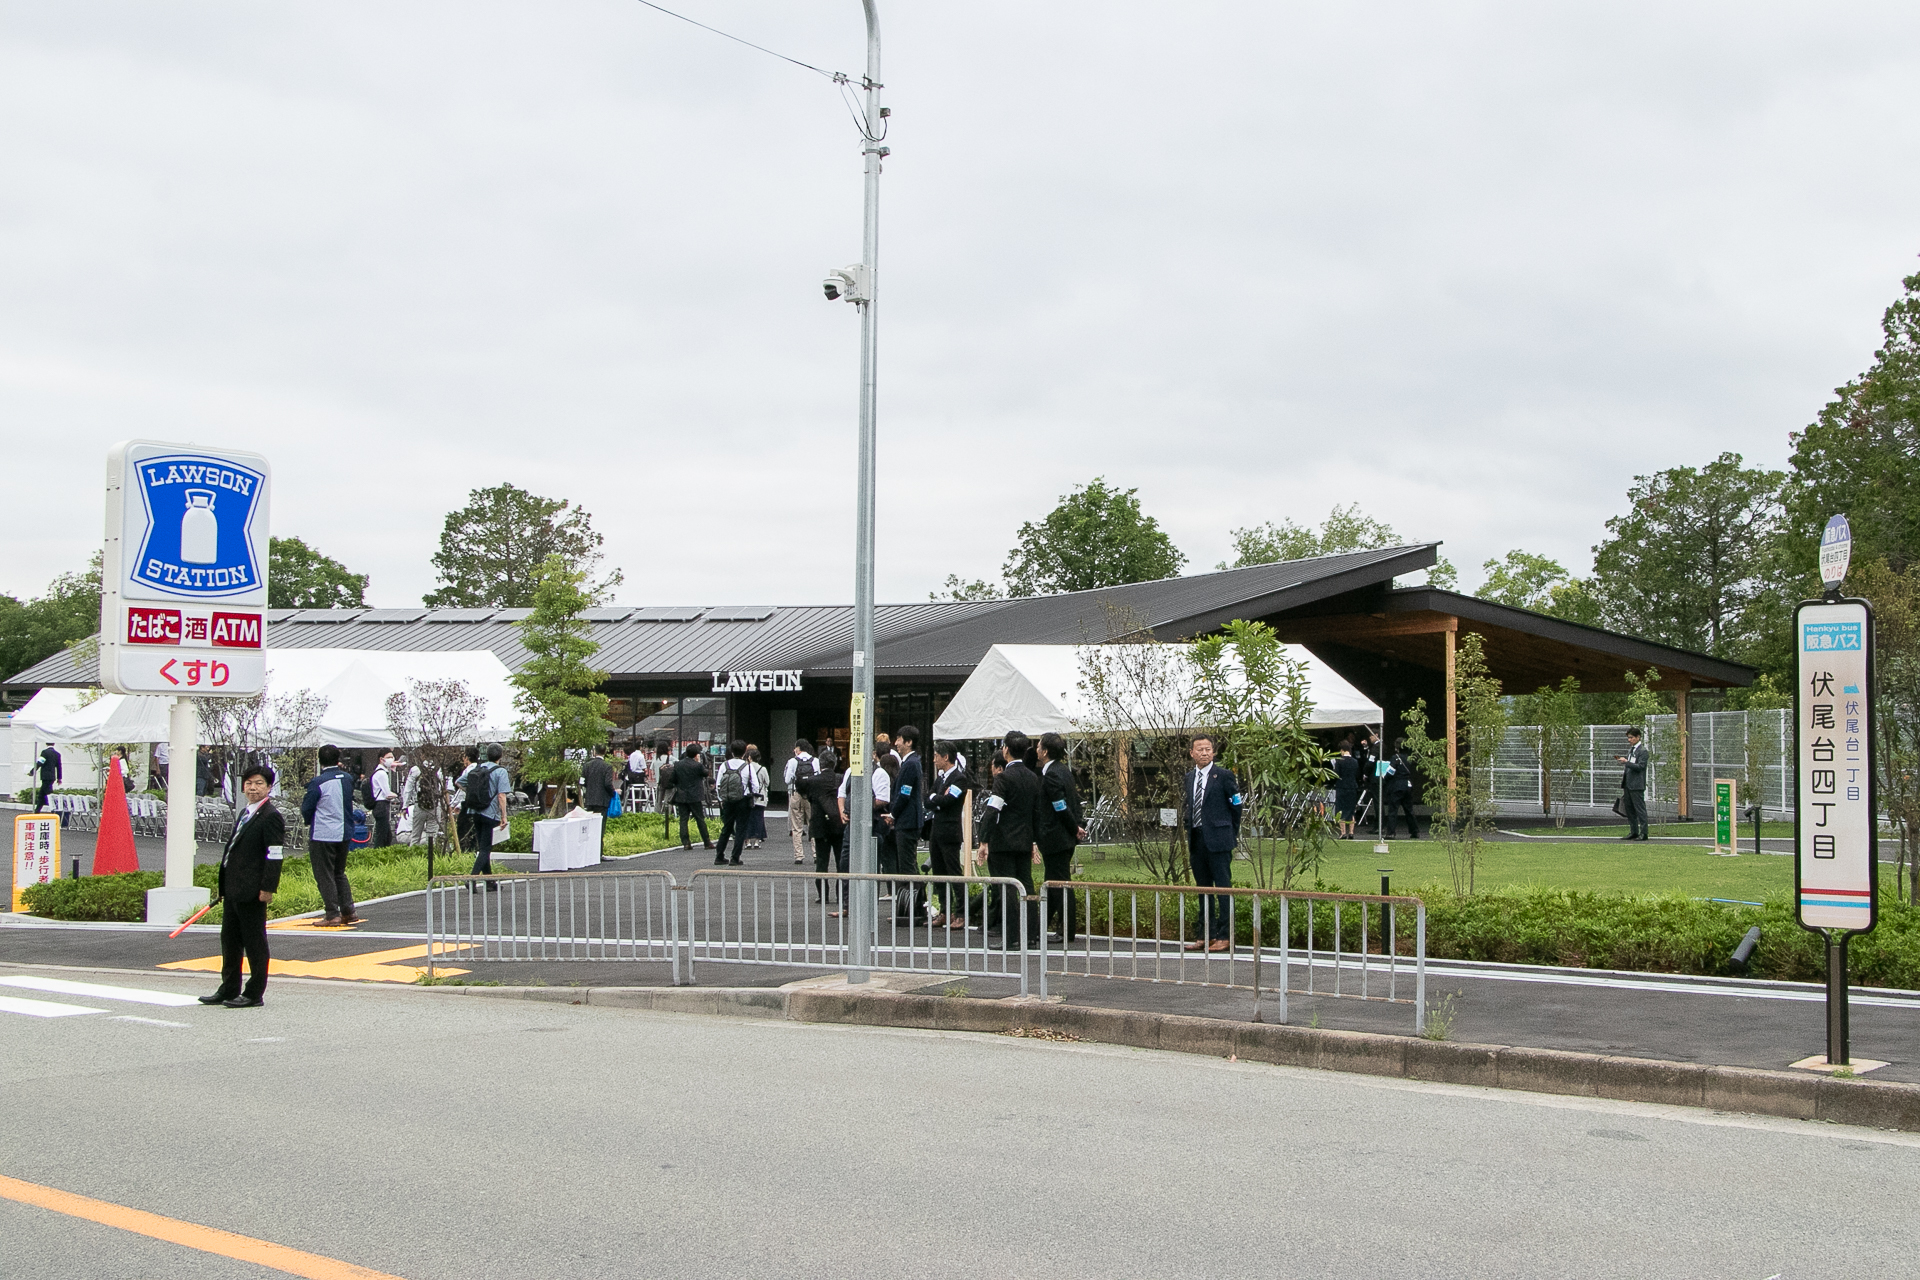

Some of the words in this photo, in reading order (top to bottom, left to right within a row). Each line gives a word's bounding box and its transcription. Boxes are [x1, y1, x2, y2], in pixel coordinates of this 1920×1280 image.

[147, 465, 253, 497] LAWSON
[1824, 524, 1847, 545] 阪急バス
[1821, 549, 1848, 565] 伏尾台四丁目
[145, 558, 249, 588] STATION
[1824, 564, 1843, 580] のりば
[131, 613, 180, 639] たばこ
[184, 617, 208, 640] 酒
[213, 617, 259, 642] ATM
[1806, 625, 1839, 633] Hankyu
[1806, 633, 1859, 650] 阪急バス
[159, 658, 230, 687] くすり
[712, 670, 803, 692] LAWSON
[1845, 700, 1860, 801] 伏尾台一丁目
[1811, 671, 1837, 860] 伏尾台四丁目
